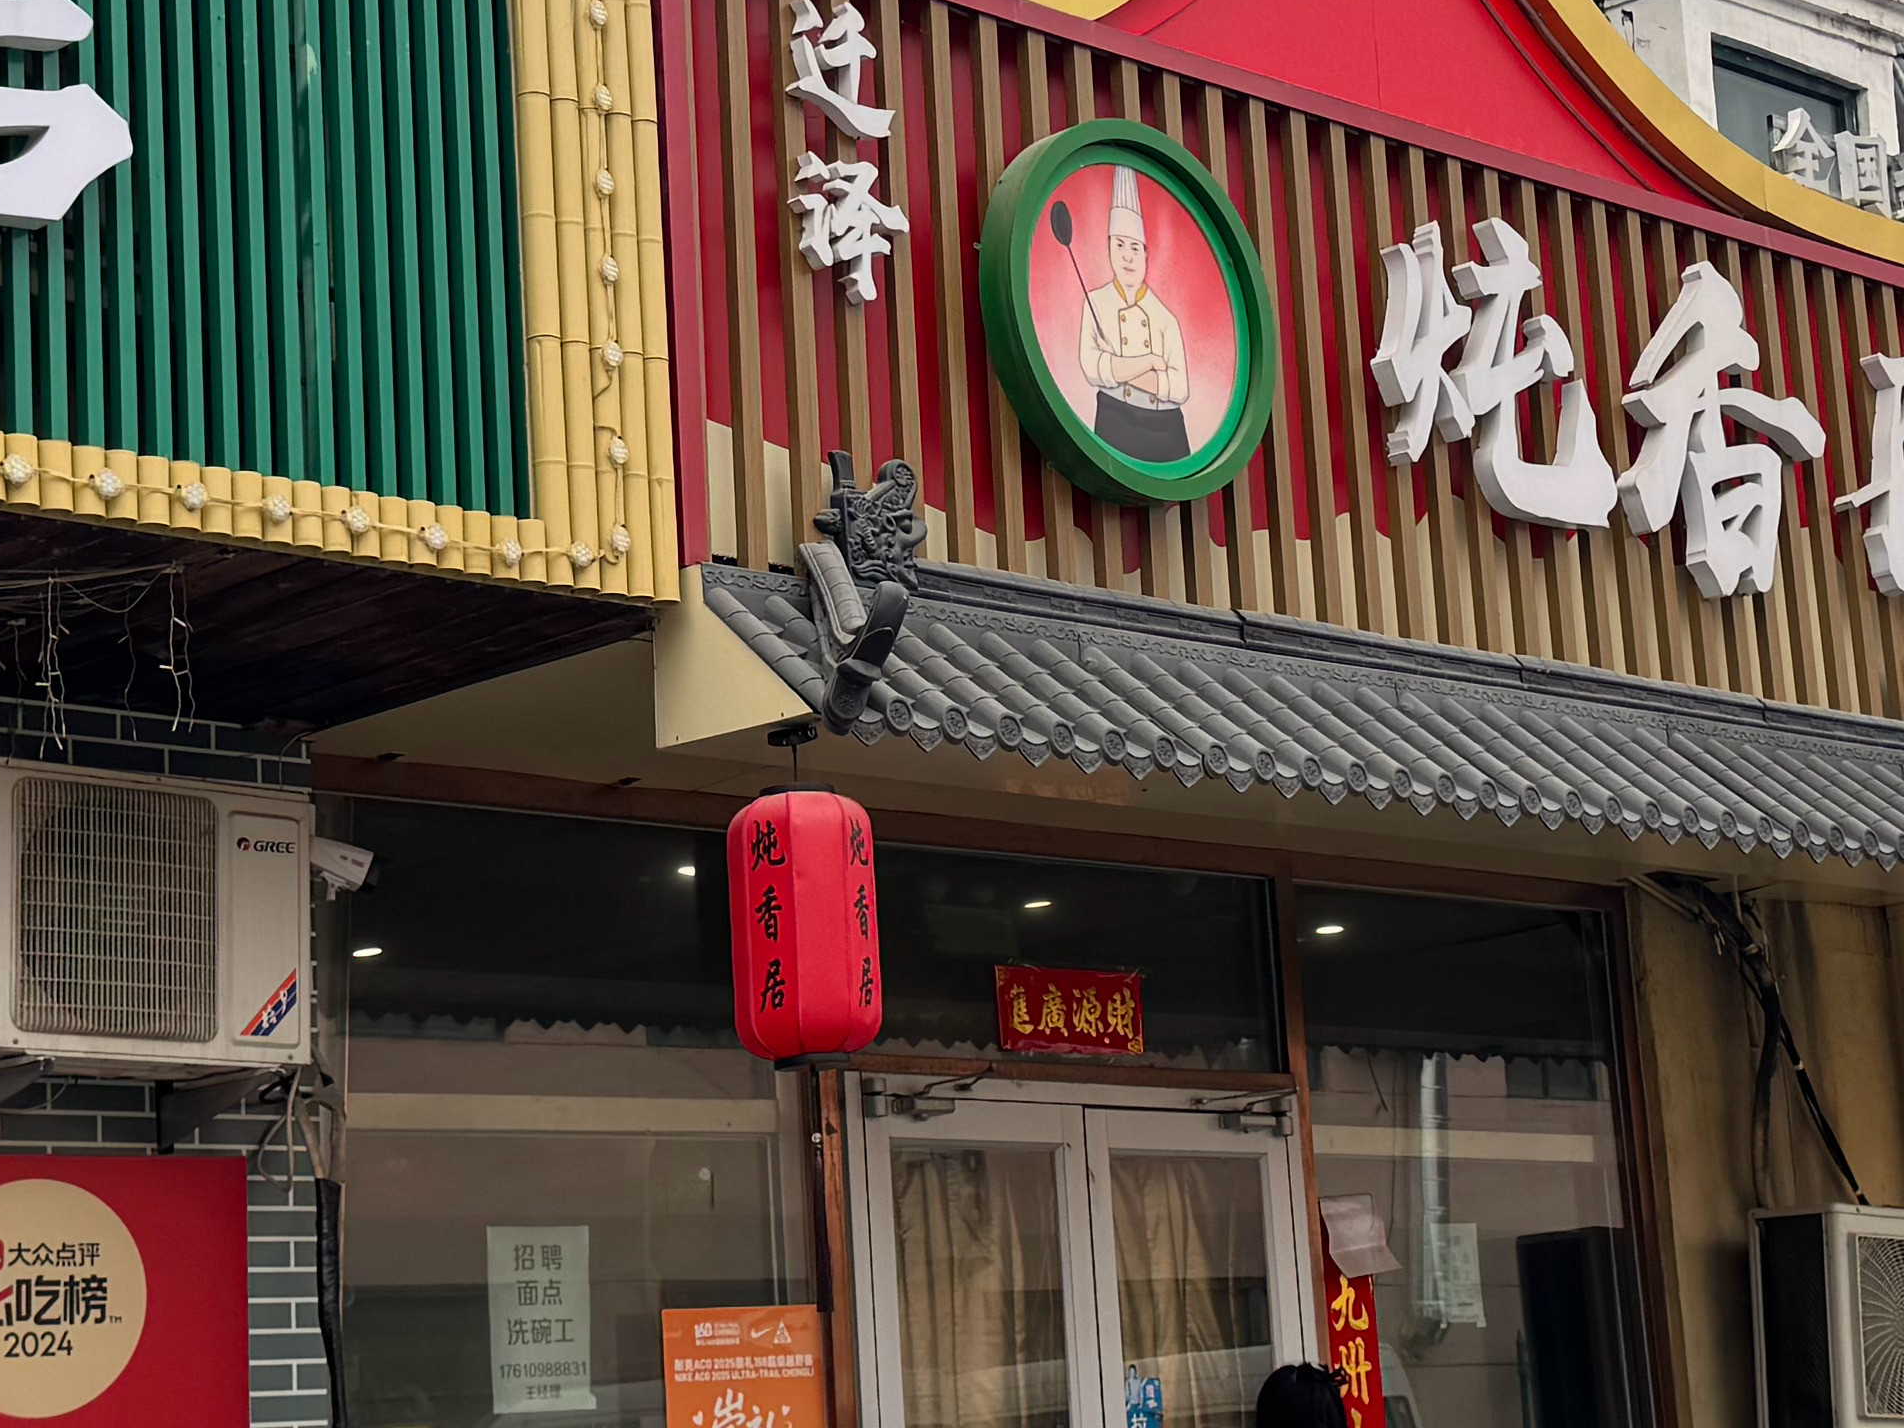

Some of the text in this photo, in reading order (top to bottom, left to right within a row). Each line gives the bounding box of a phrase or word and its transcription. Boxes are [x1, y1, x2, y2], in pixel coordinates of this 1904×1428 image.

[253, 839, 296, 854] GREE
[750, 820, 787, 1014] 炖香居
[848, 816, 875, 1009] 炖香居
[8, 1242, 101, 1268] 大众点评
[514, 1243, 563, 1271] 招聘
[516, 1278, 563, 1306] 面点
[3, 1331, 74, 1358] 2024
[507, 1318, 575, 1346] 洗碗工
